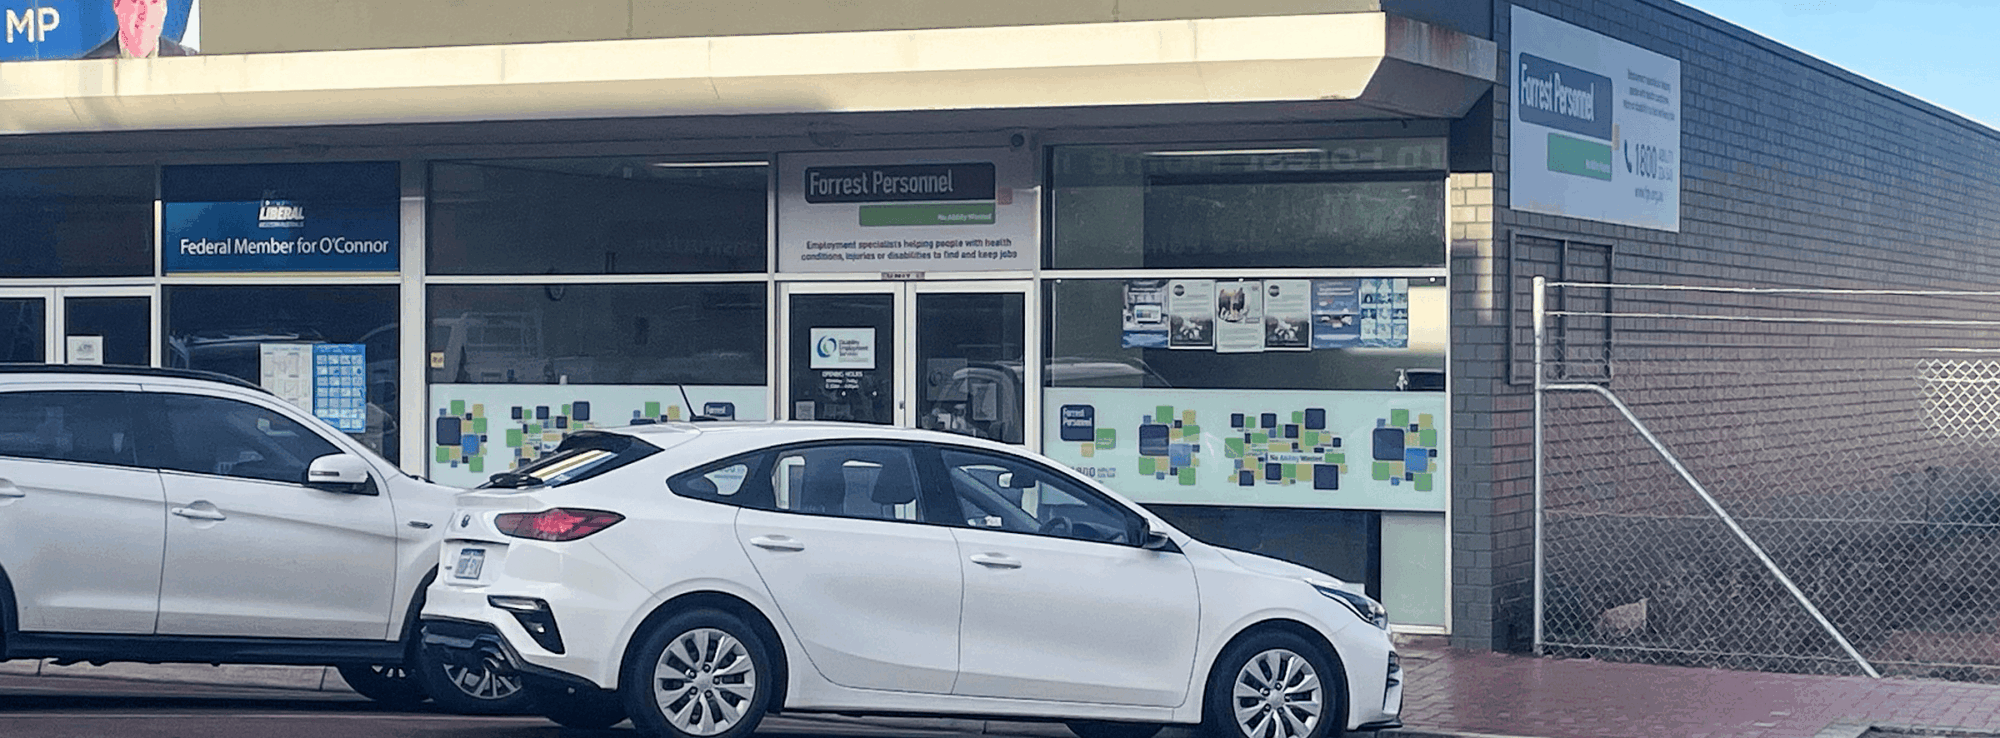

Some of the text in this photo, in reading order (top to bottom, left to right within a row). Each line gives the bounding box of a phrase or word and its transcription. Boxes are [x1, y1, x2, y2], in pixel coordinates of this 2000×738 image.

[6, 7, 60, 43] MP
[1520, 63, 1553, 112] Forrest
[1554, 72, 1595, 121] Personnel
[1635, 143, 1657, 178] 1800
[809, 169, 954, 195] Forrest Personnel
[259, 206, 305, 220] LIBERAL
[180, 237, 389, 254] Federal Member for O'Connor
[806, 238, 1012, 250] Employment specialists helping people with health
[801, 252, 845, 261] conditions,
[846, 252, 876, 261] injuries
[888, 250, 932, 260] disabilities
[934, 251, 942, 259] to
[944, 250, 959, 259] find
[961, 250, 976, 259] and
[978, 250, 998, 260] keep
[999, 250, 1018, 260] jobs
